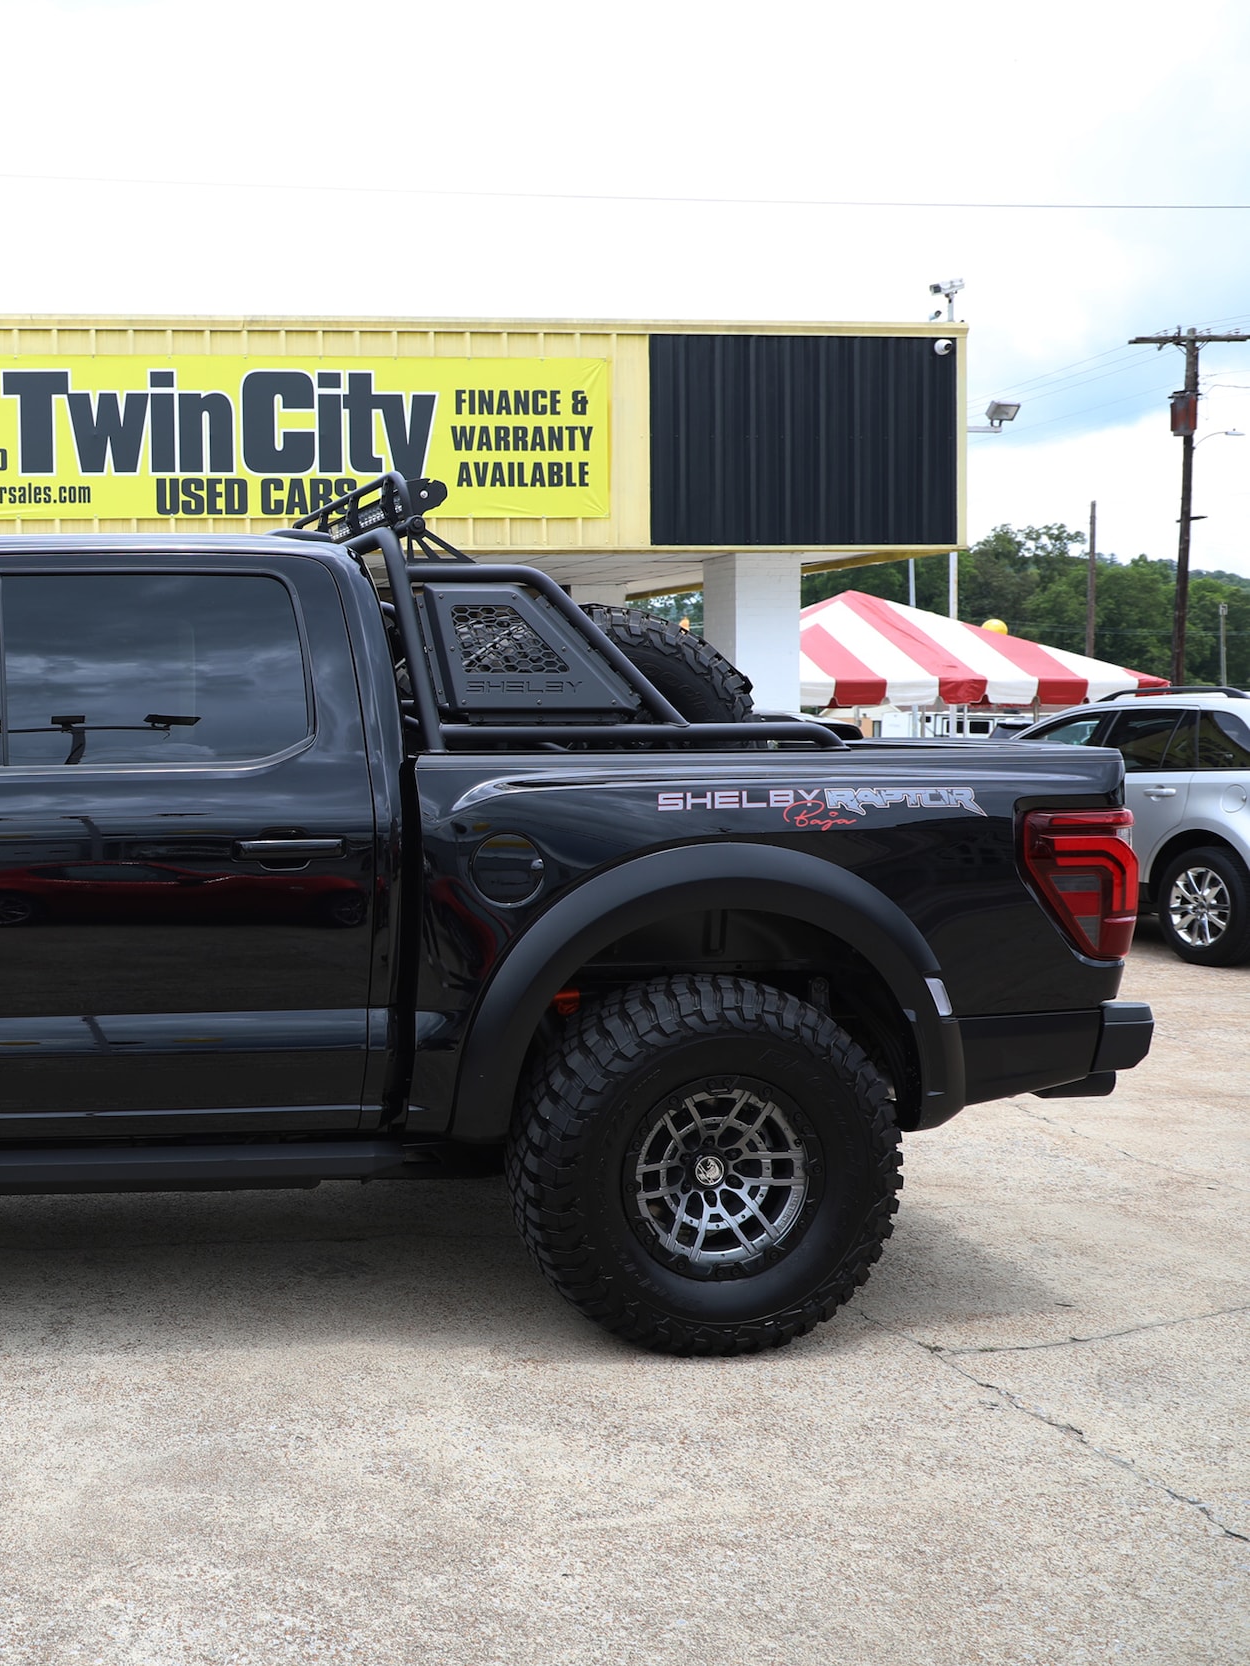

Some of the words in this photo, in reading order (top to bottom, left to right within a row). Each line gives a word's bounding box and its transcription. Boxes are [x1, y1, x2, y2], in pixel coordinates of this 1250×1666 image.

[454, 389, 561, 416] FINANCE
[571, 390, 588, 415] &
[451, 425, 593, 452] WARRANTY
[456, 461, 589, 488] AVAILABLE
[156, 479, 248, 515] USED
[466, 680, 582, 694] SHELBY
[657, 789, 820, 812] SHELBY
[823, 787, 988, 817] RAPTOR
